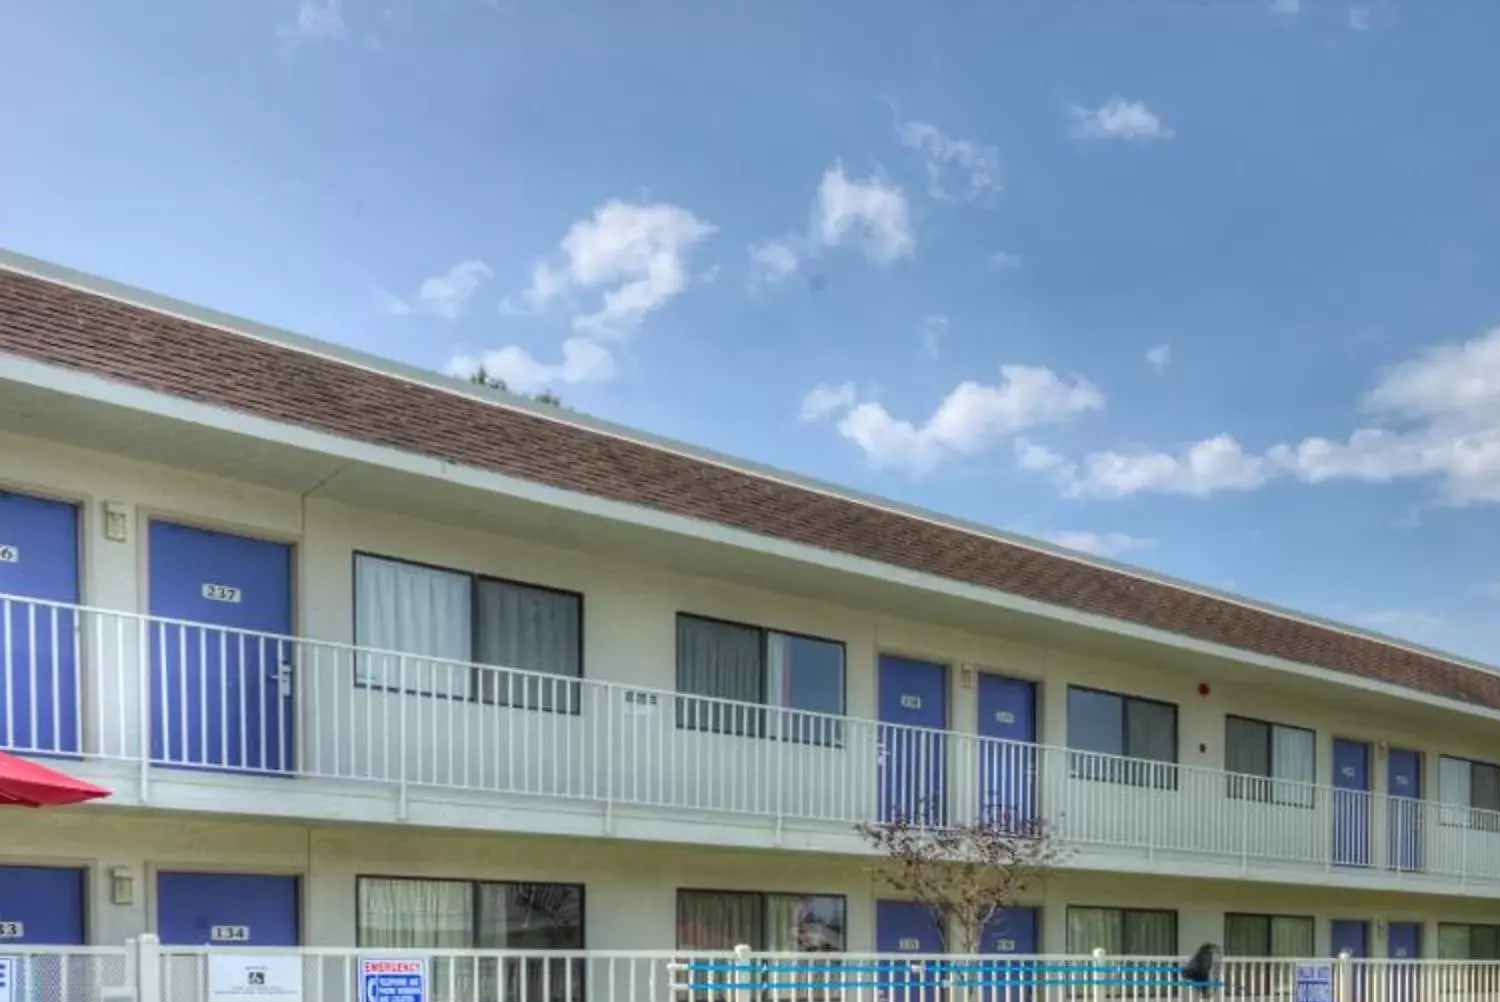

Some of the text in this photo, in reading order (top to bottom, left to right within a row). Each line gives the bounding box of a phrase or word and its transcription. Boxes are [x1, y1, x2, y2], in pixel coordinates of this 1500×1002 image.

[207, 584, 237, 601] 237
[217, 927, 244, 938] 134
[364, 961, 421, 972] EMERGENCY
